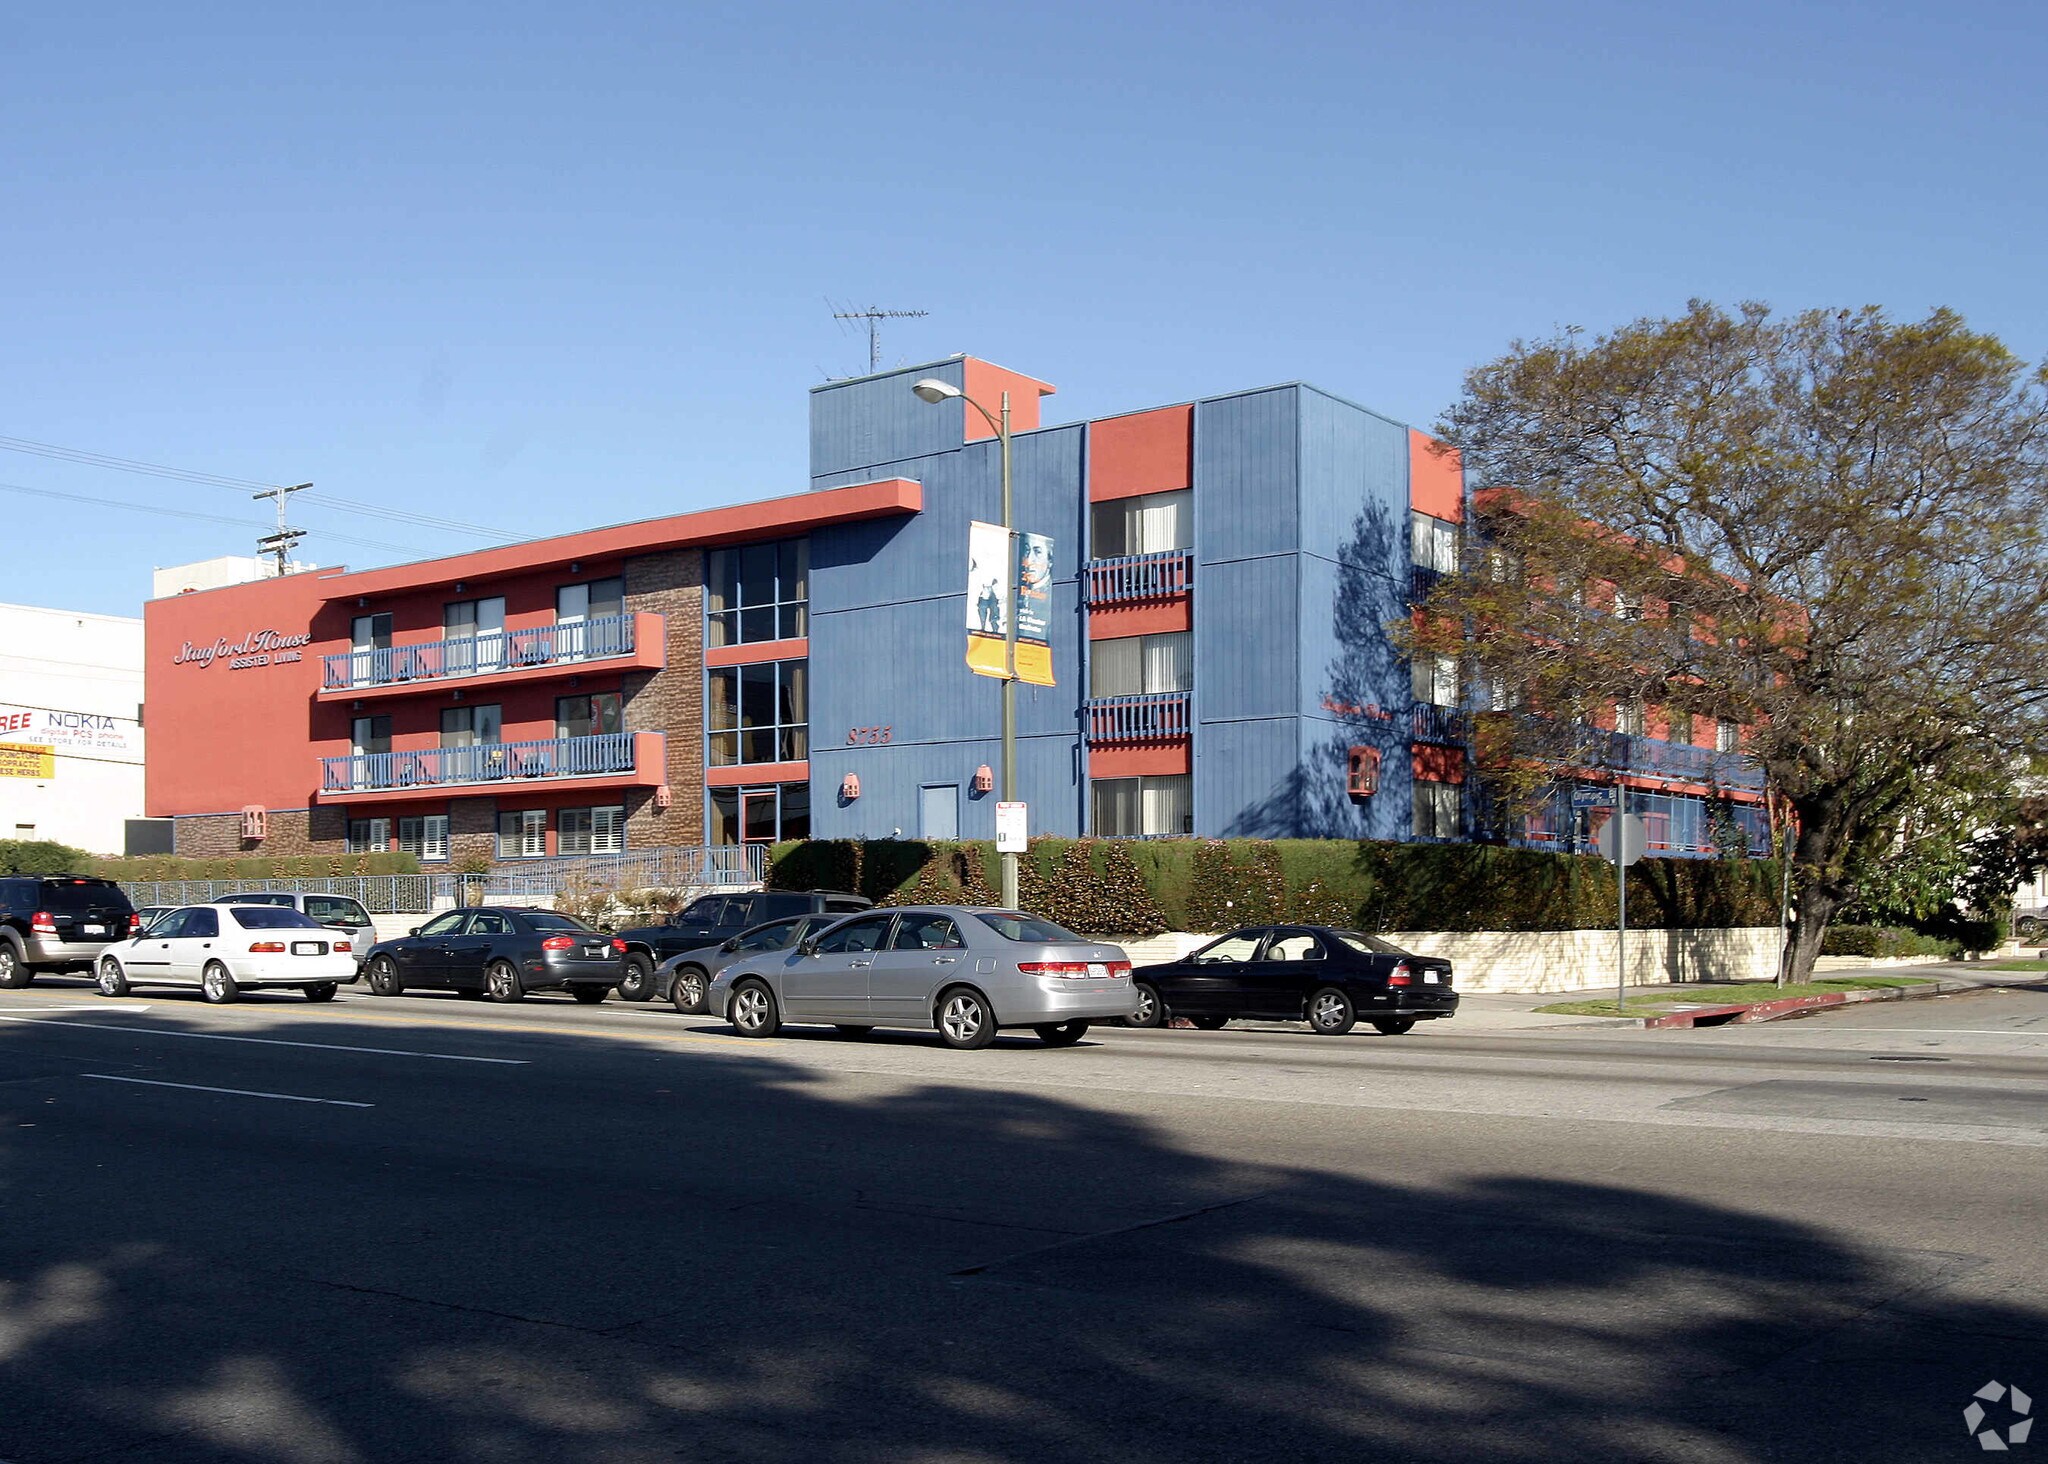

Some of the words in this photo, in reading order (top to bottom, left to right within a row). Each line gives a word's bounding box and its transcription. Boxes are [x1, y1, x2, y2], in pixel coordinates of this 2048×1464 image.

[174, 631, 252, 668] Stanford
[249, 628, 312, 653] House
[229, 653, 270, 670] ASSISTED
[273, 650, 302, 664] LIVING
[48, 713, 115, 730] NOKIA
[29, 735, 43, 743] SEE
[49, 737, 72, 745] STORE
[97, 740, 127, 749] DETAILS
[73, 729, 93, 739] PCS
